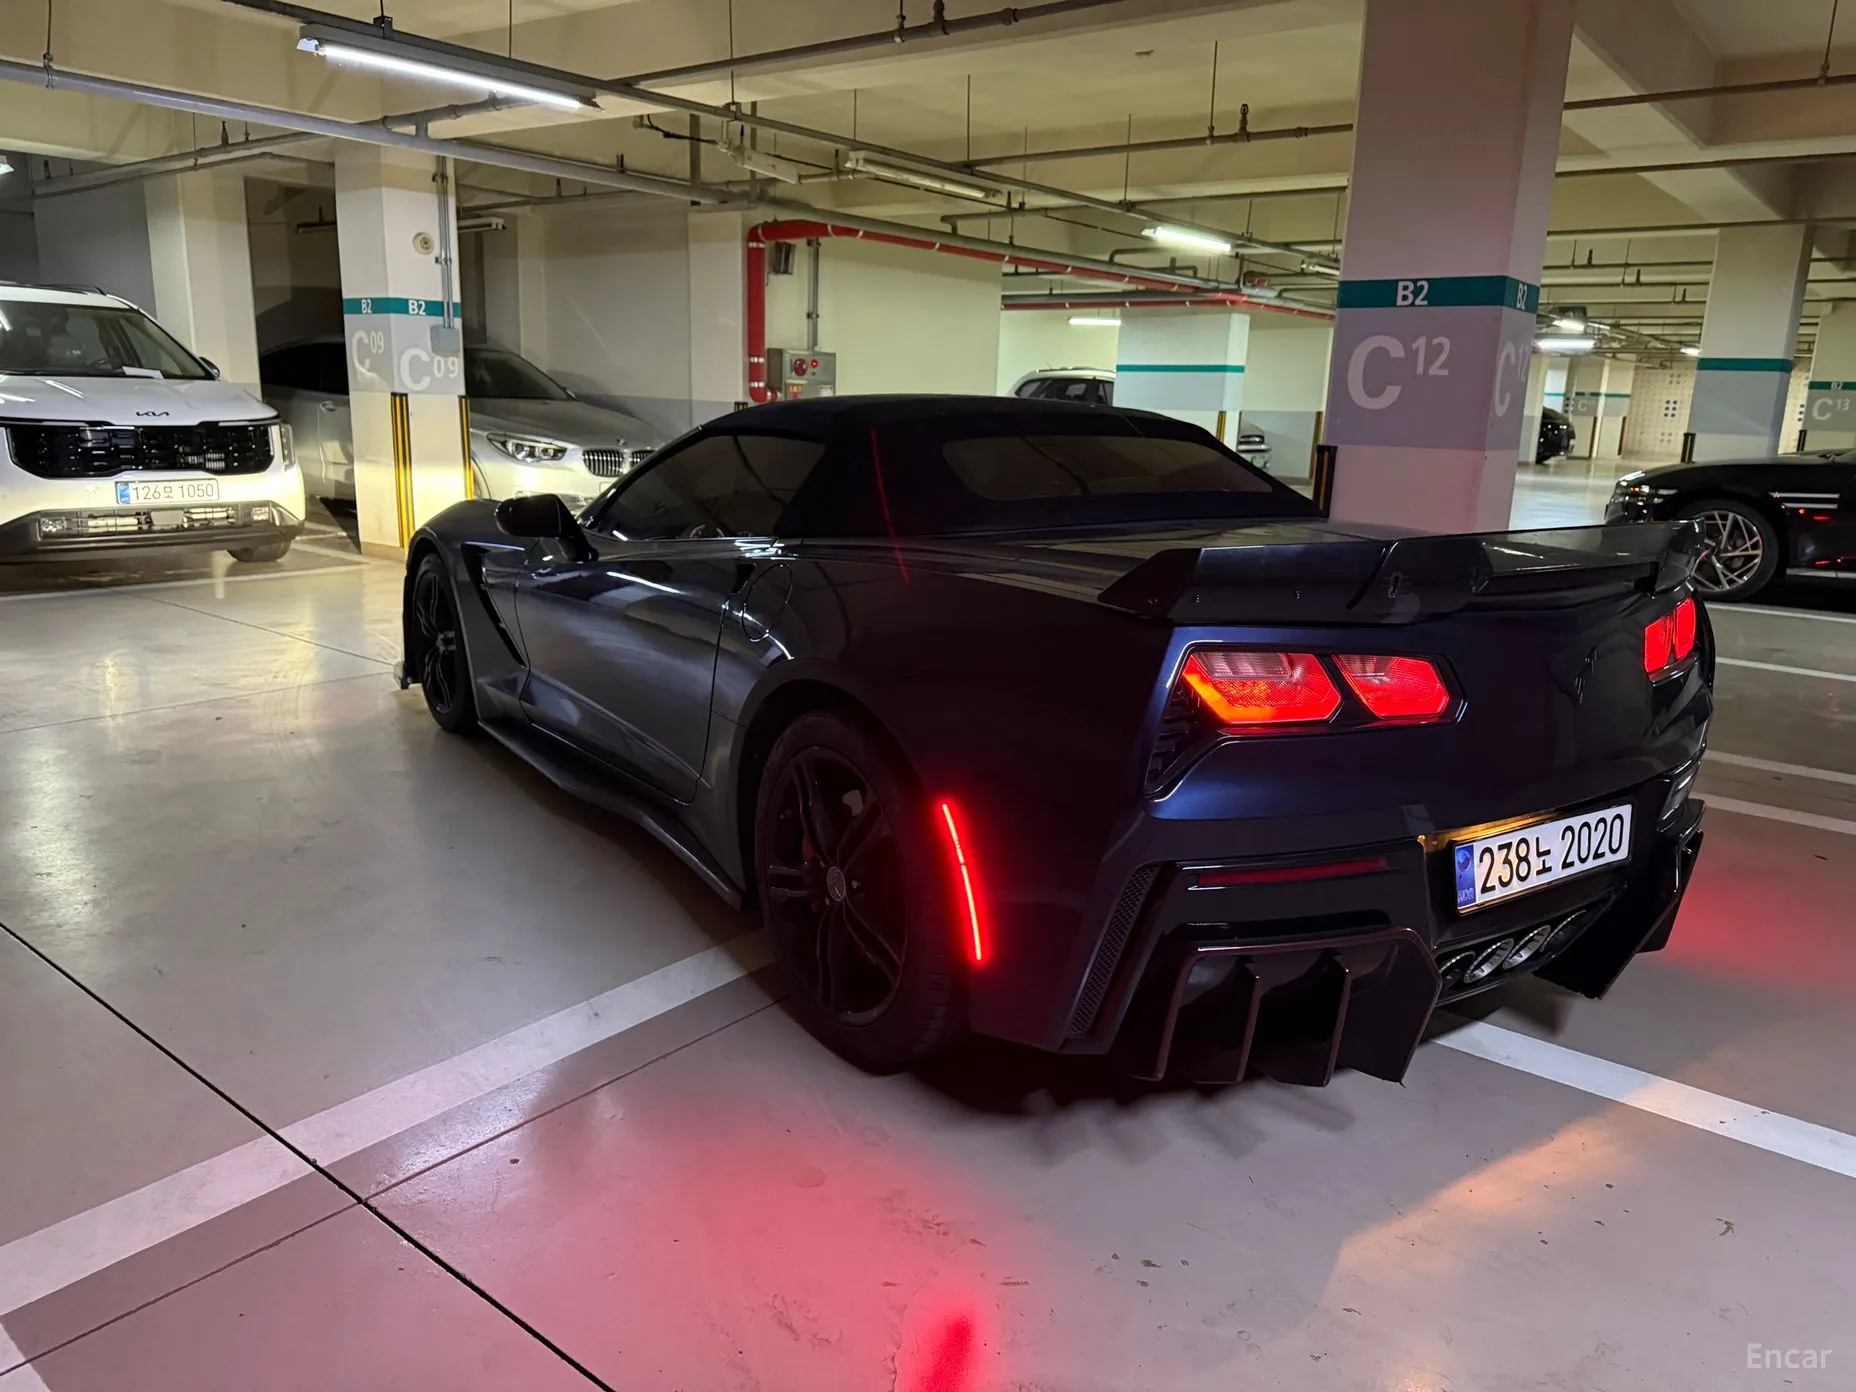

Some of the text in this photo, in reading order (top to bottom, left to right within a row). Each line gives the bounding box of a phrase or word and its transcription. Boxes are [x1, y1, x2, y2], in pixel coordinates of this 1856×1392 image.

[1396, 278, 1429, 307] B2
[1516, 282, 1528, 310] B2
[361, 299, 372, 314] B2
[408, 299, 426, 315] B2
[132, 484, 174, 501] 126모
[178, 483, 214, 498] 1050
[1479, 813, 1624, 894] 238노 2020
